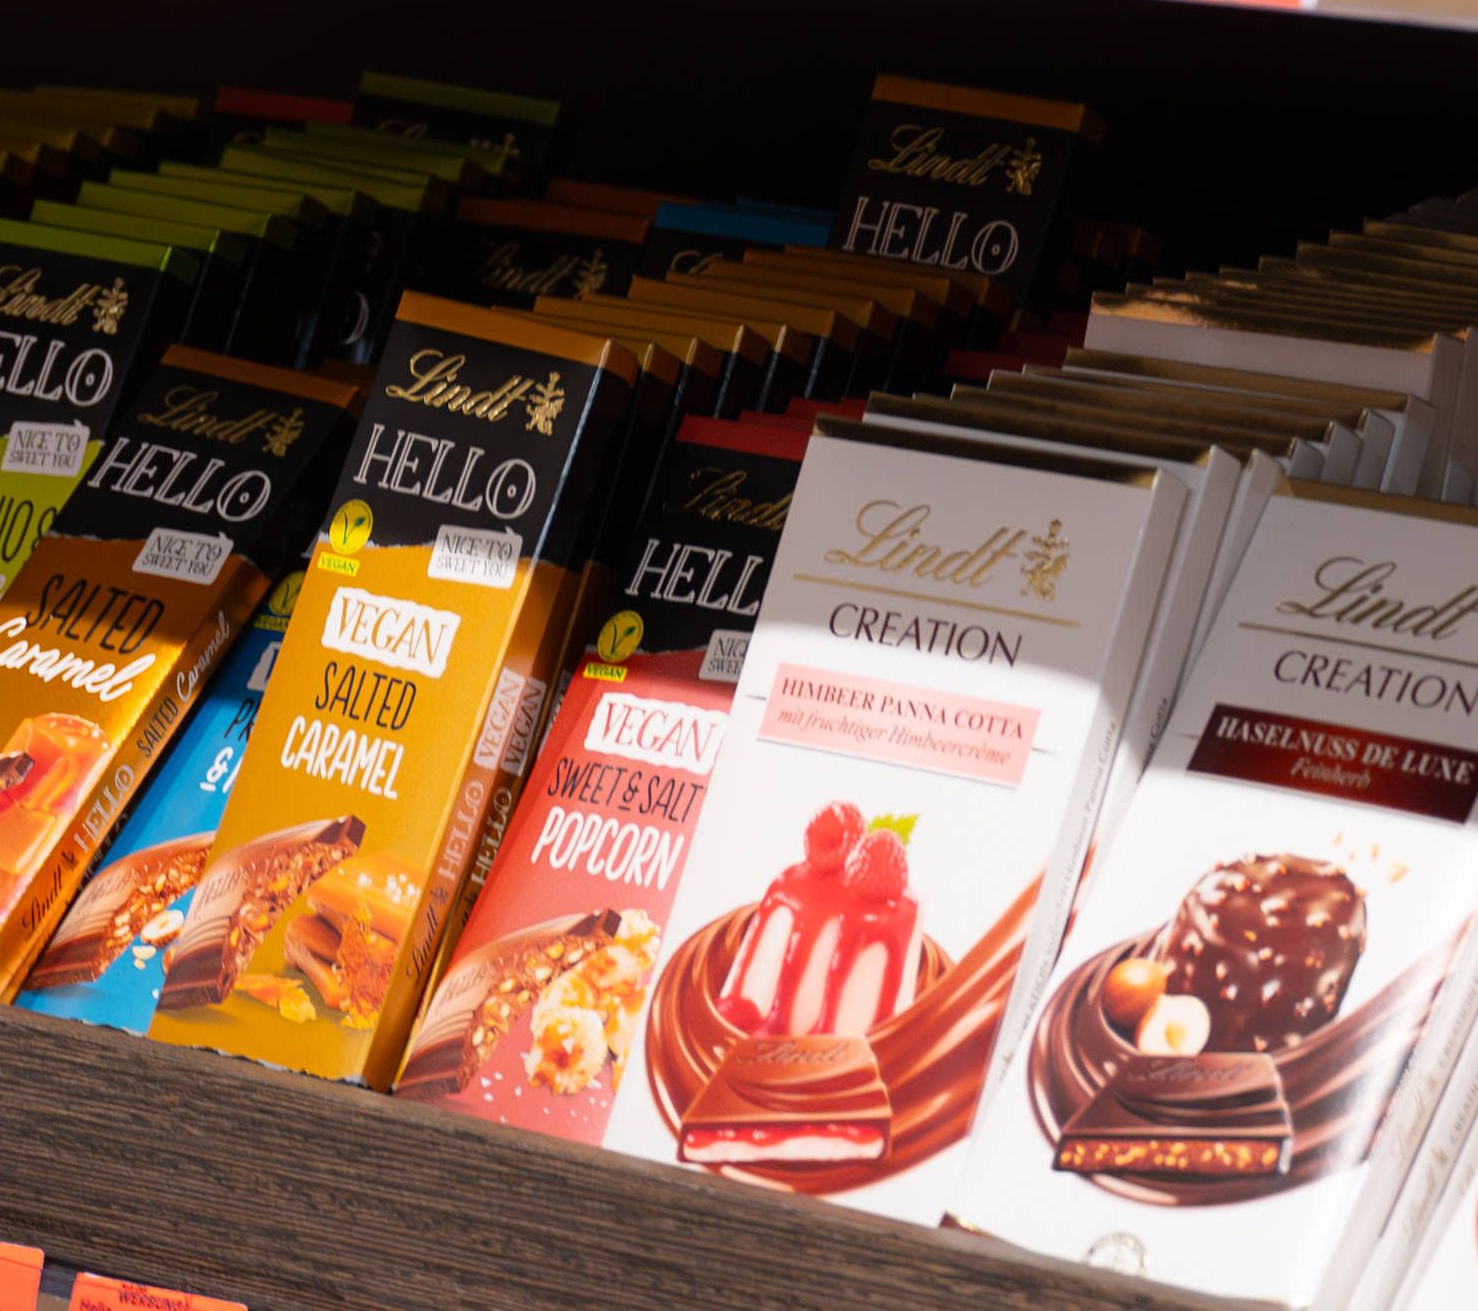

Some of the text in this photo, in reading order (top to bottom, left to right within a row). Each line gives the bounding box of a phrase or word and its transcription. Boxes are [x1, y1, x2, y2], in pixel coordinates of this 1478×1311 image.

[844, 194, 1023, 275] HELLO
[13, 428, 50, 452] NICE
[353, 421, 538, 520] HELLO
[86, 436, 274, 525] HELLO
[149, 535, 188, 558] NICE
[825, 497, 1021, 588] Lindt
[20, 572, 165, 657] SALTED
[332, 593, 454, 669] VEGAN
[827, 602, 1025, 670] CREATION
[314, 659, 418, 732] SALTED
[601, 701, 717, 762] VEGAN
[782, 677, 1024, 740] HIMBEER PANNA COTTA
[280, 714, 401, 801] CARAMEL
[1214, 714, 1477, 787] HASELNUSS DE LUXE
[549, 757, 624, 803] SWEET
[640, 775, 705, 823] SALT
[531, 803, 684, 889] POPCORN
